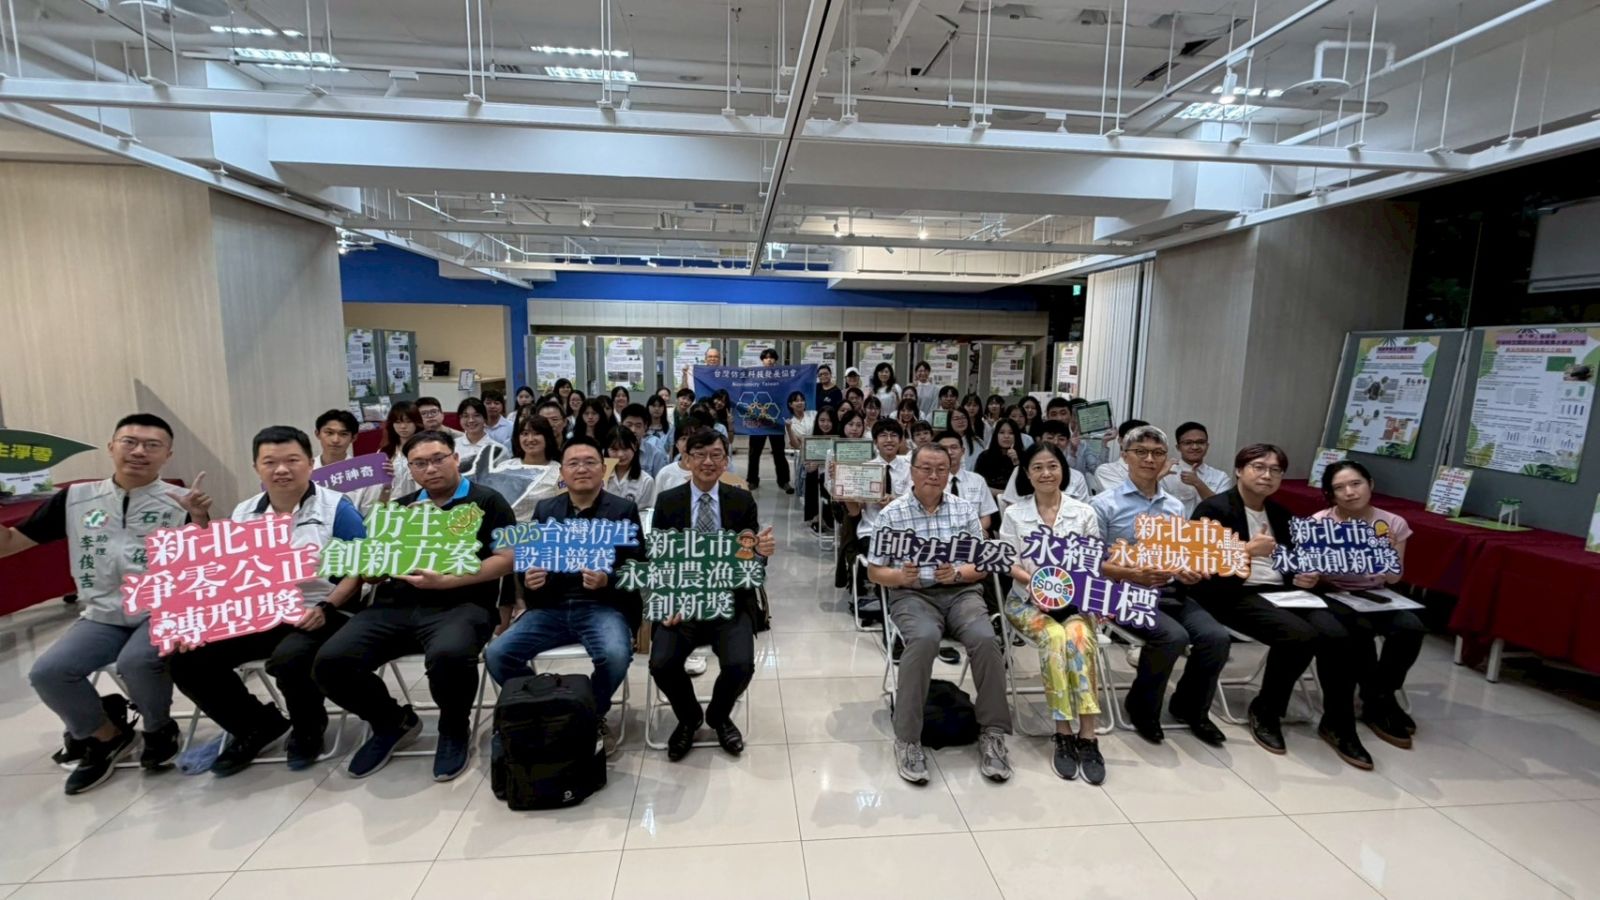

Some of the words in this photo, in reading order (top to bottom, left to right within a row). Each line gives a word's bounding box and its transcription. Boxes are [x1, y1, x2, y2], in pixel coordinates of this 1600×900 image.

[363, 503, 444, 539] 仿生
[493, 517, 640, 549] 2025台灣仿生
[1136, 515, 1219, 545] 新北市
[1291, 517, 1367, 545] 新北市
[95, 534, 108, 556] 助理
[147, 514, 293, 567] 新北市
[646, 529, 734, 559] 新北市
[875, 527, 1015, 573] 師法自然
[1023, 525, 1105, 577] 永續
[79, 535, 96, 589] 李俊吉
[319, 539, 481, 577] 創新方案
[513, 545, 615, 573] 設計競賽
[615, 560, 763, 590] 永續農漁業
[1110, 538, 1251, 578] 永續城市獎
[1272, 546, 1401, 575] 永續創新獎
[124, 545, 319, 613] 淨零公正
[1036, 578, 1069, 596] SDGs
[645, 591, 735, 621] 創新獎
[1081, 575, 1159, 628] 目標
[152, 589, 305, 651] 轉型獎
